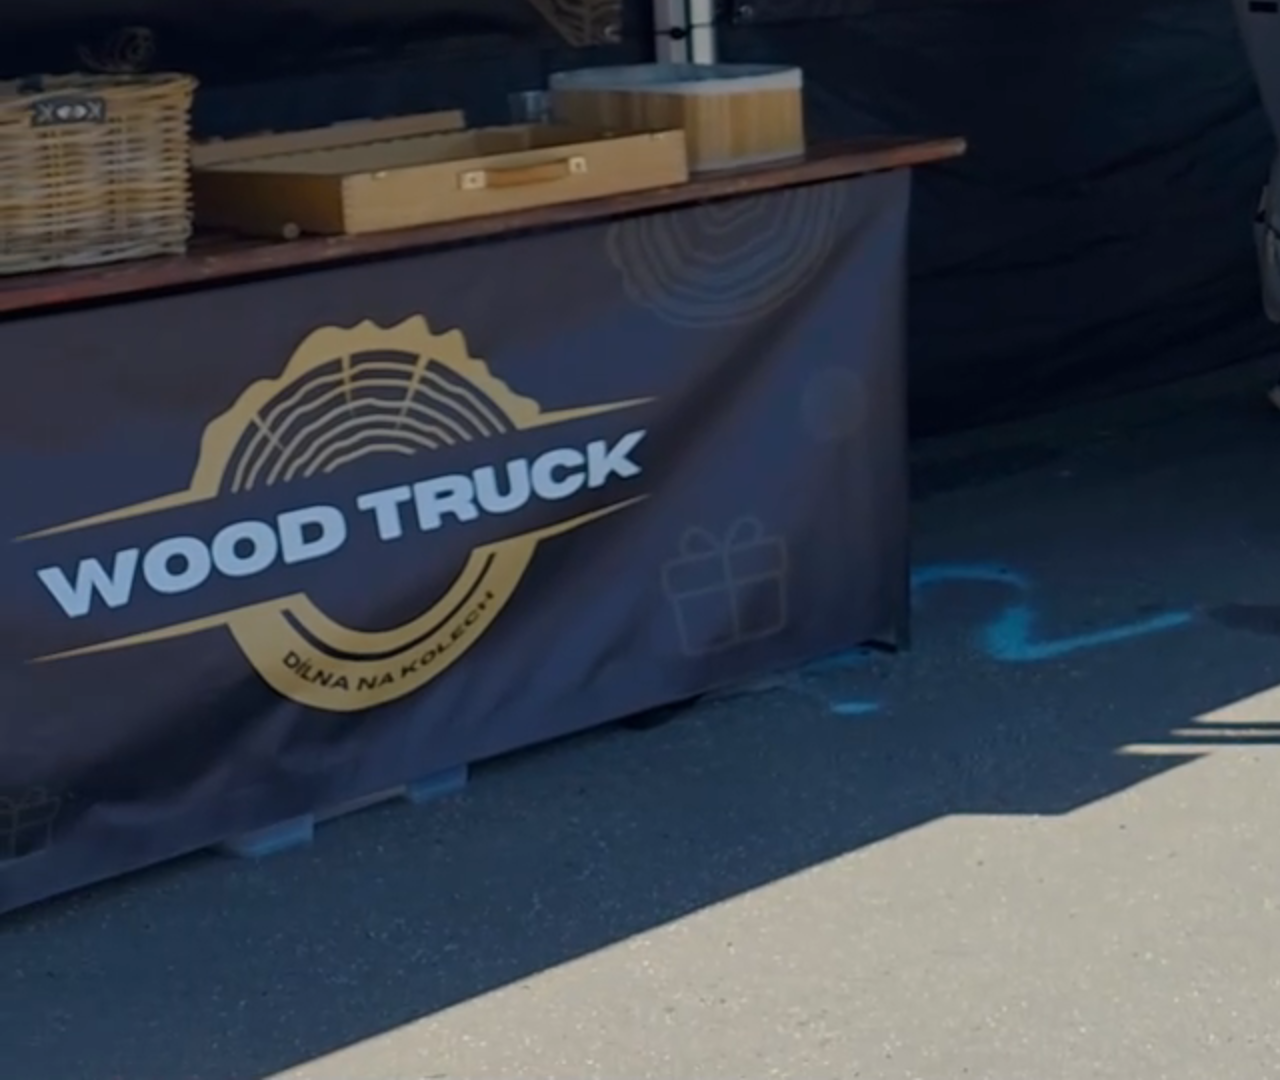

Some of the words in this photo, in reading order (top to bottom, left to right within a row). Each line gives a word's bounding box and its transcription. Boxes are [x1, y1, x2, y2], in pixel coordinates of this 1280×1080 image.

[37, 505, 347, 618] WOOD
[357, 430, 647, 541] TRUCK
[282, 649, 350, 692] DÍLNA
[356, 675, 396, 692] NA
[401, 589, 495, 679] KOLECH
